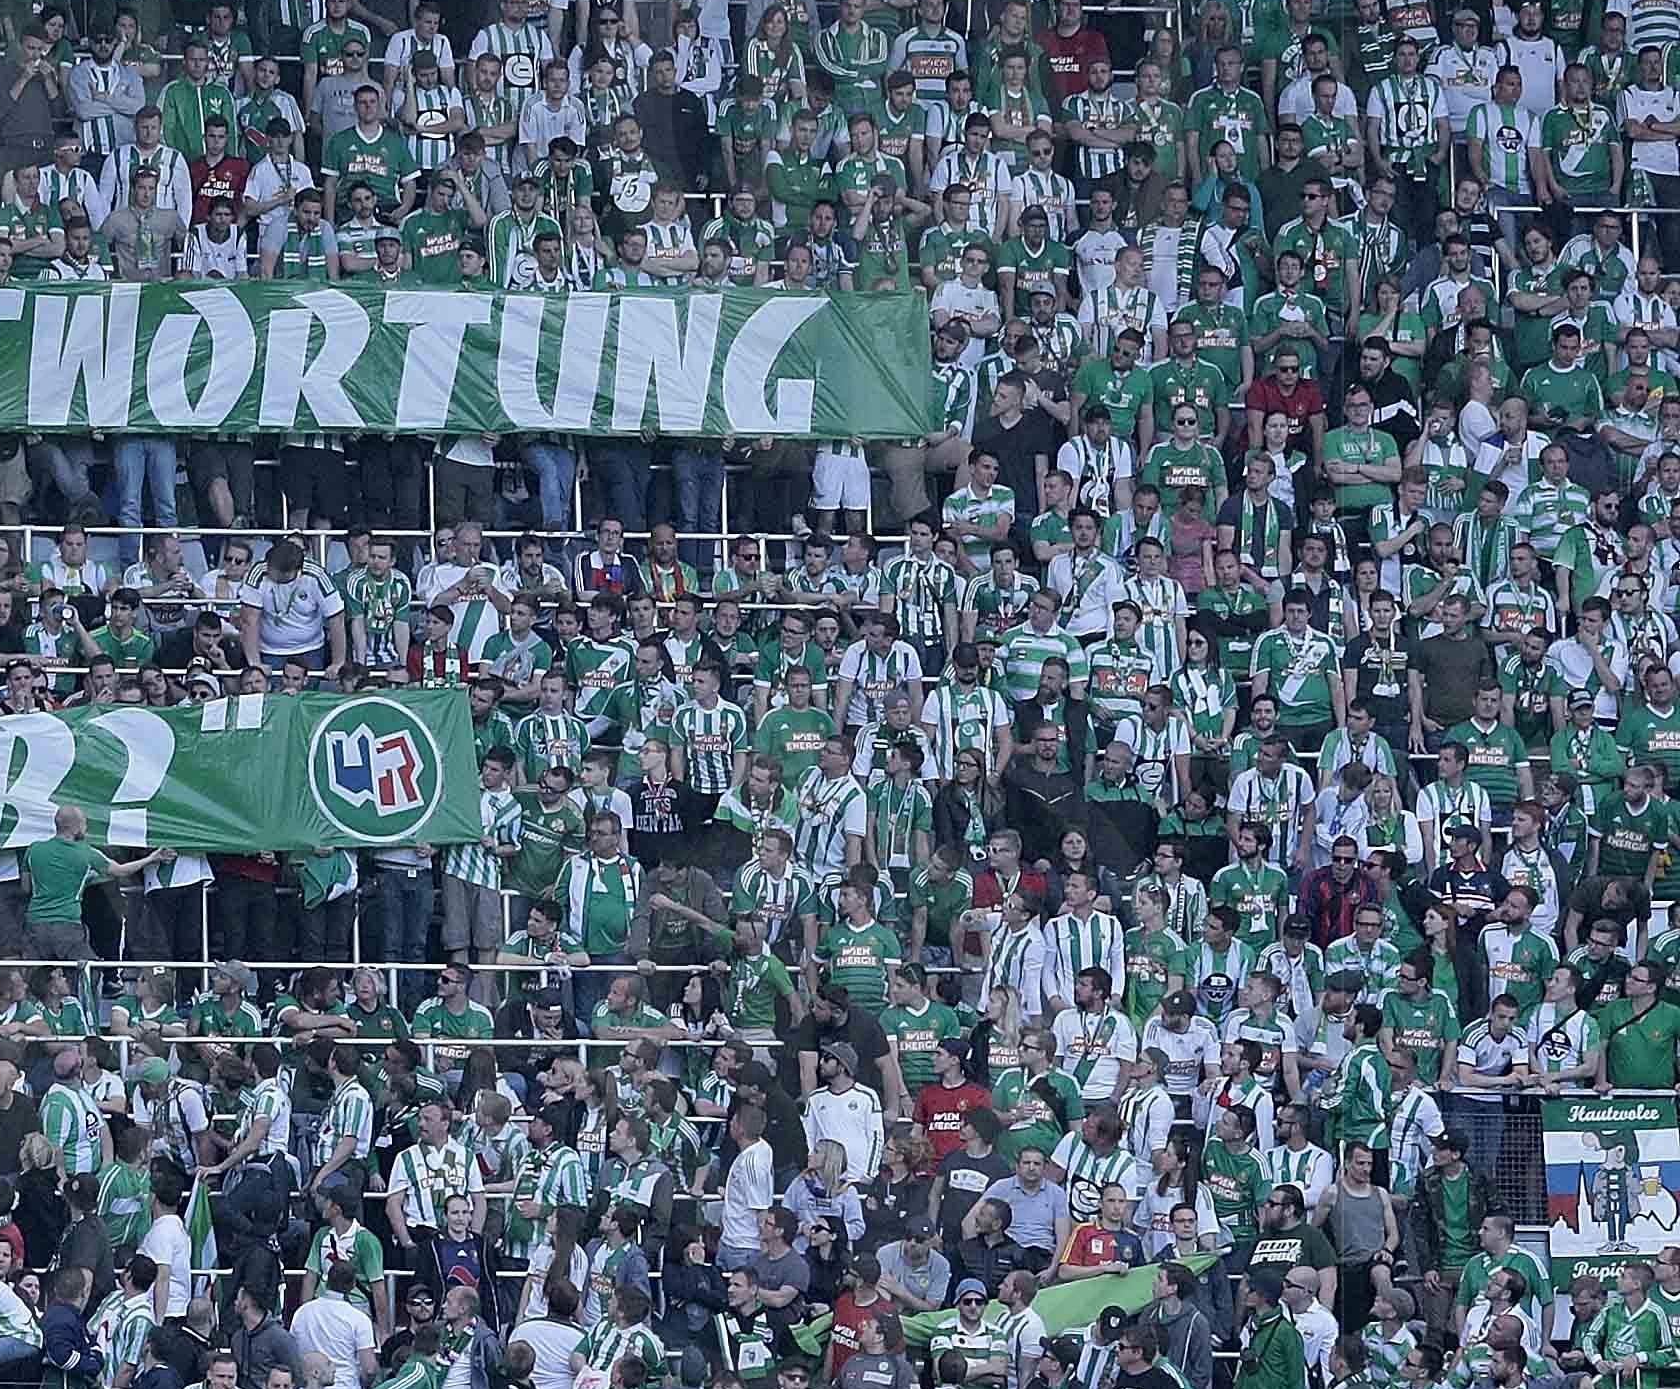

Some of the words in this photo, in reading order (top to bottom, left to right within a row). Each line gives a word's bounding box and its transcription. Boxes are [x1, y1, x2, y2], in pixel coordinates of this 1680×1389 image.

[357, 154, 381, 162] WIEN
[1173, 468, 1201, 476] WIEN
[1166, 476, 1207, 486] ENERGIE
